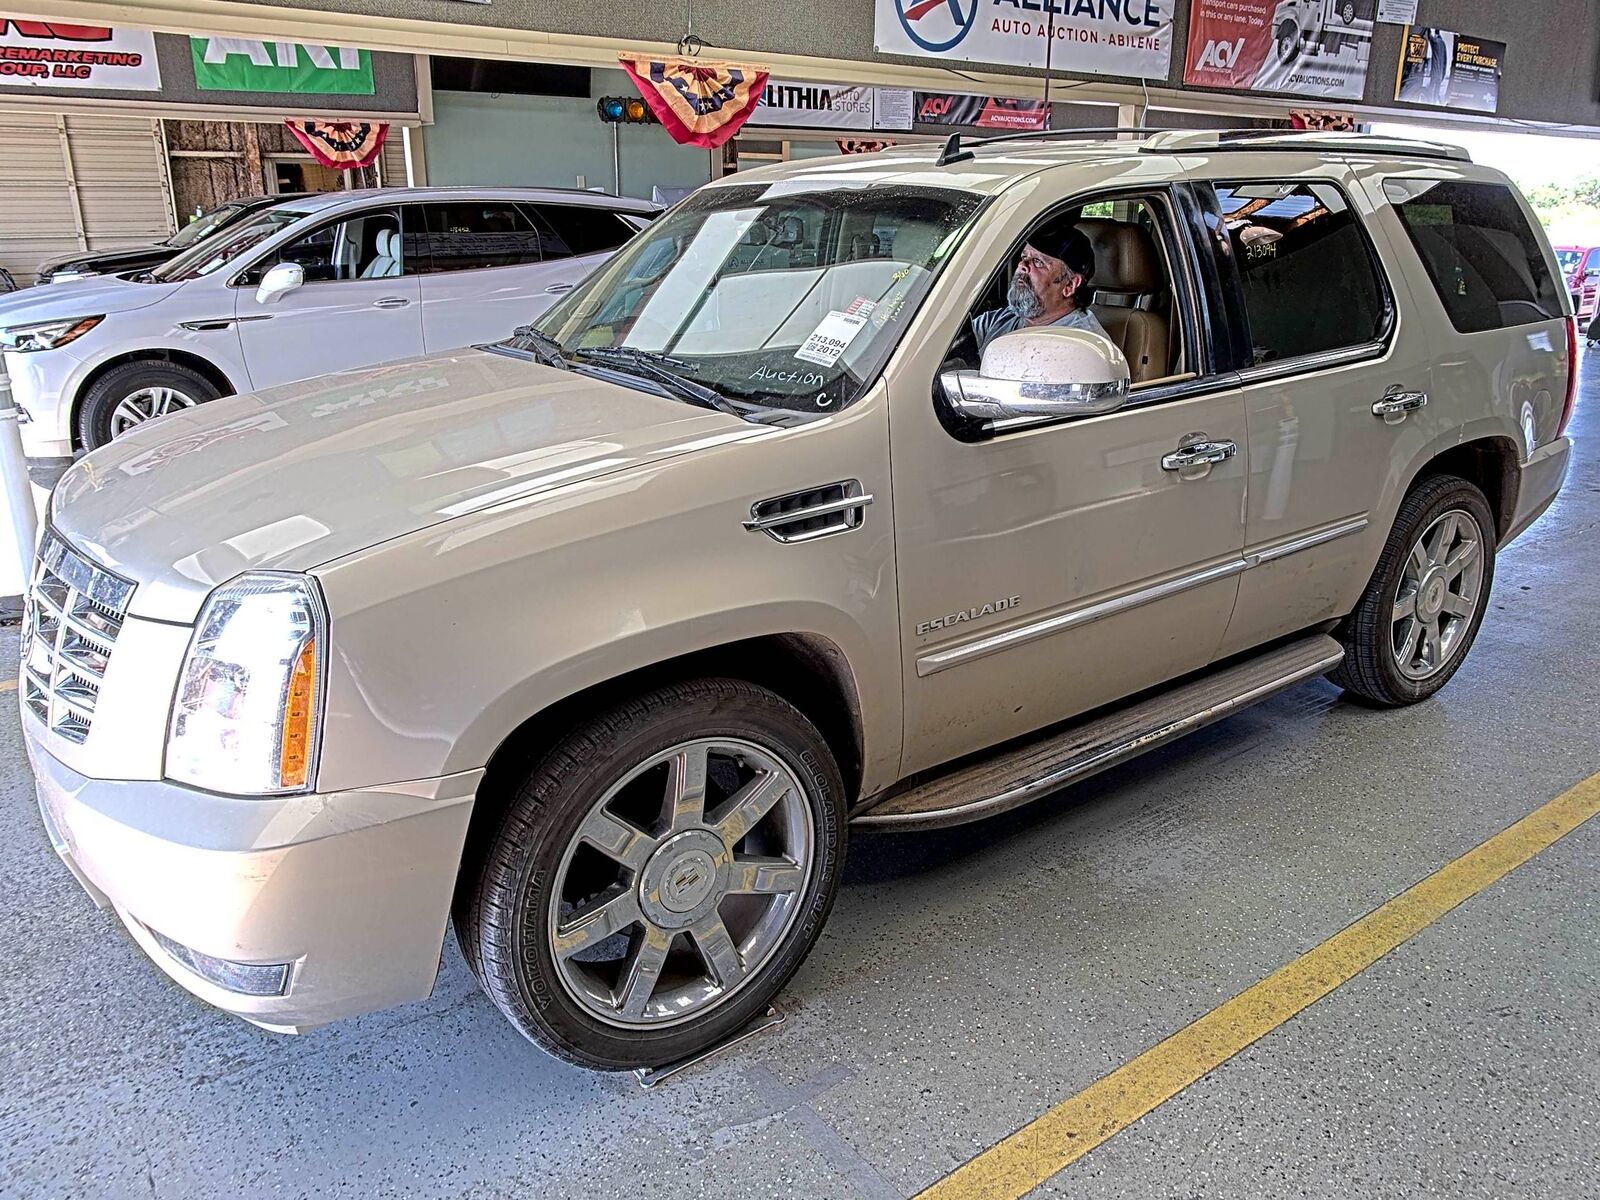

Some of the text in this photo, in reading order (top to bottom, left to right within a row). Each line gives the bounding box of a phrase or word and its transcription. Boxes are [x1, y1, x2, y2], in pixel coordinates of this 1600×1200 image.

[993, 0, 1160, 28] ANCE
[1206, 10, 1216, 19] this
[1217, 12, 1223, 20] or
[1223, 13, 1233, 23] any
[1226, 2, 1238, 10] cars
[1239, 4, 1266, 14] purchased
[992, 18, 1031, 36] AUTO
[1037, 24, 1099, 44] AUCTION
[1108, 34, 1160, 51] ABILENE
[1195, 37, 1246, 71] ACV
[1456, 52, 1473, 63] EVERY
[1457, 43, 1480, 54] PROTECT
[0, 61, 92, 79] OUP, LLC
[1289, 74, 1345, 87] CVAUCTIONS.COM
[767, 85, 860, 111] LITHIA AUTO
[835, 101, 871, 113] STORES
[920, 96, 954, 115] ACV
[990, 114, 1037, 125] ACVAUCTIONS.COM
[1246, 243, 1277, 259] 213094
[816, 344, 841, 358] 2012
[748, 364, 824, 387] Auction
[915, 595, 1021, 635] ESCALADE
[800, 749, 837, 882] GEOLANDAR
[523, 870, 553, 1011] YOKOHAMA
